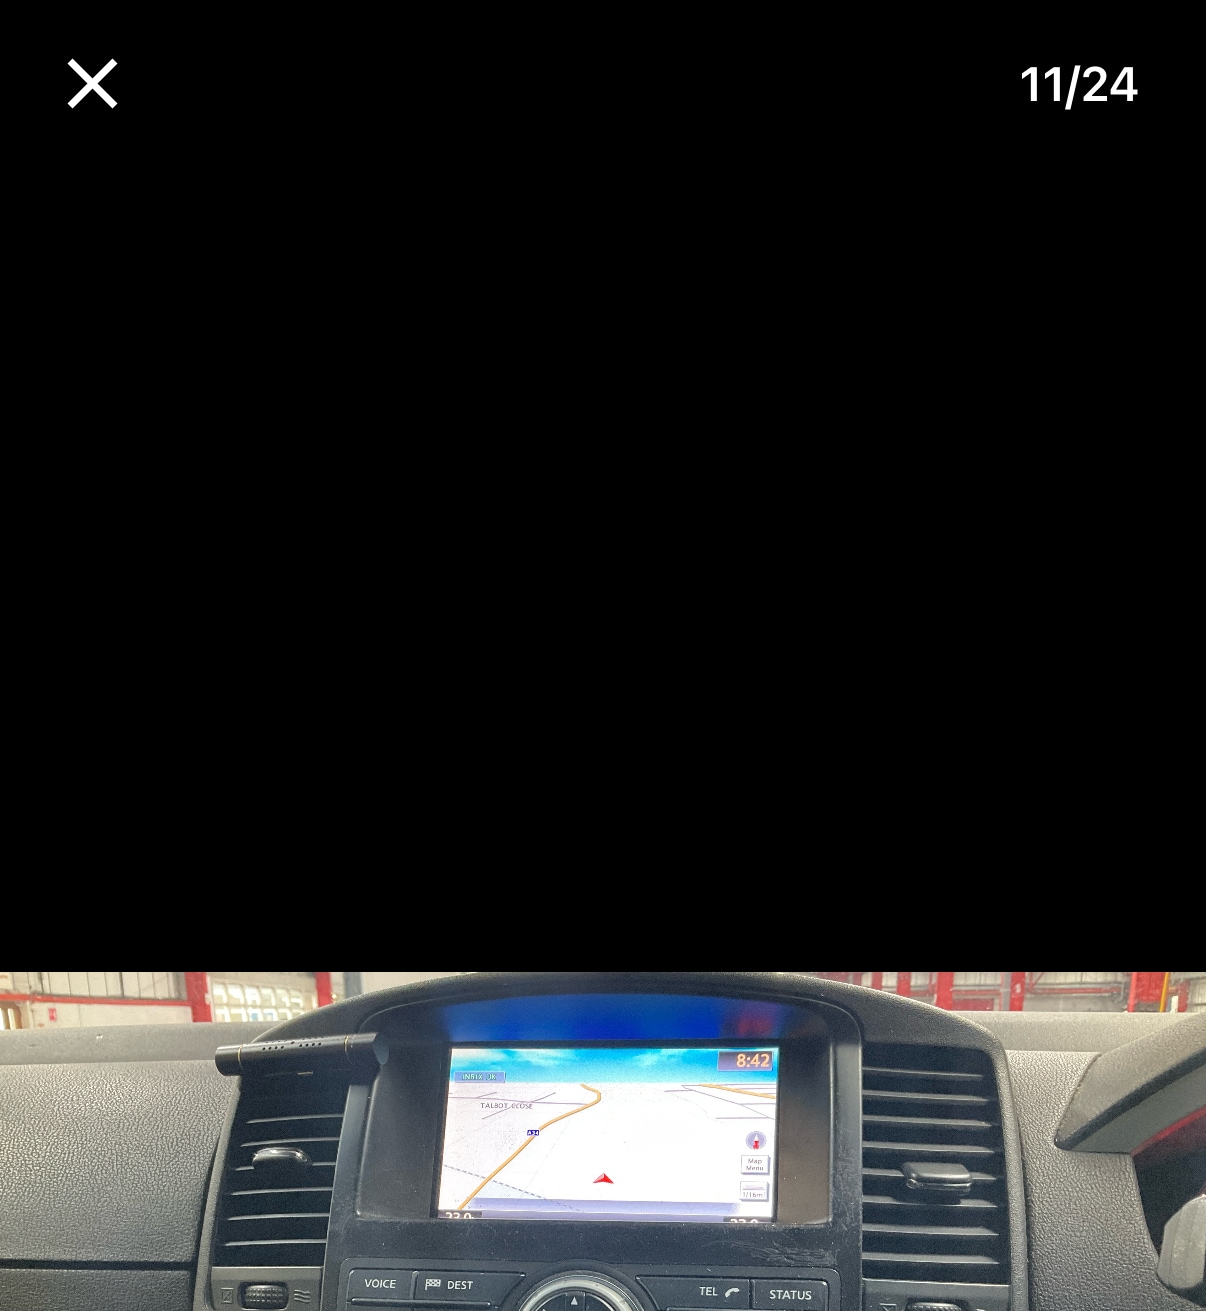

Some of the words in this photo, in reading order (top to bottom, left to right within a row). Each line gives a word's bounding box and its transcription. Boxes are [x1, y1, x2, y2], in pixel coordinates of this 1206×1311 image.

[736, 1053, 770, 1068] 8:42
[364, 1278, 397, 1289] VOICE
[447, 1280, 474, 1290] DEST
[699, 1286, 718, 1297] TEL
[769, 1289, 812, 1301] STATUS
